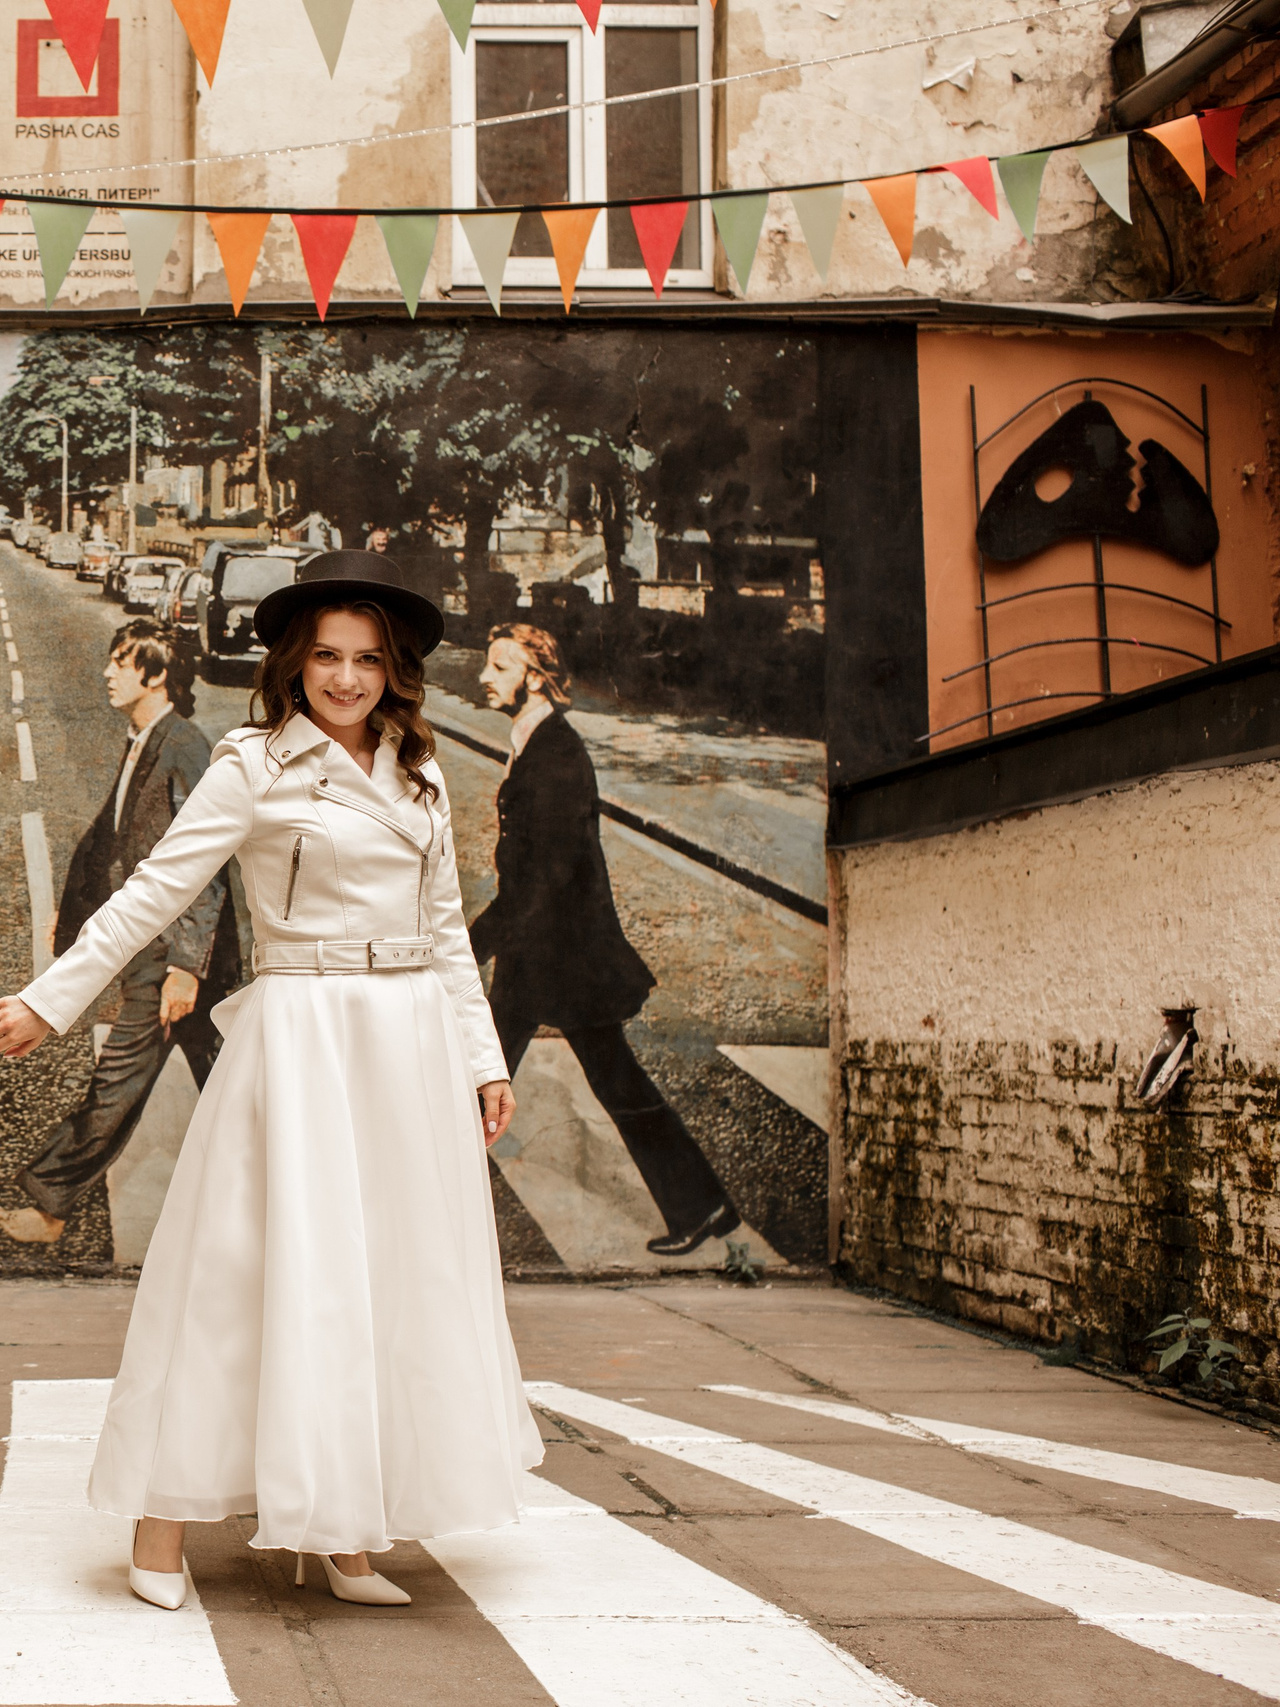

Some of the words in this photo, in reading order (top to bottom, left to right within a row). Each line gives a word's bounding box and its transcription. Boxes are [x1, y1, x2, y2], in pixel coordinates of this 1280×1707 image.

[16, 124, 77, 138] PASHA
[82, 123, 120, 138] CAS
[97, 188, 160, 200] ПИТЕР!"
[66, 269, 101, 279] OKICH
